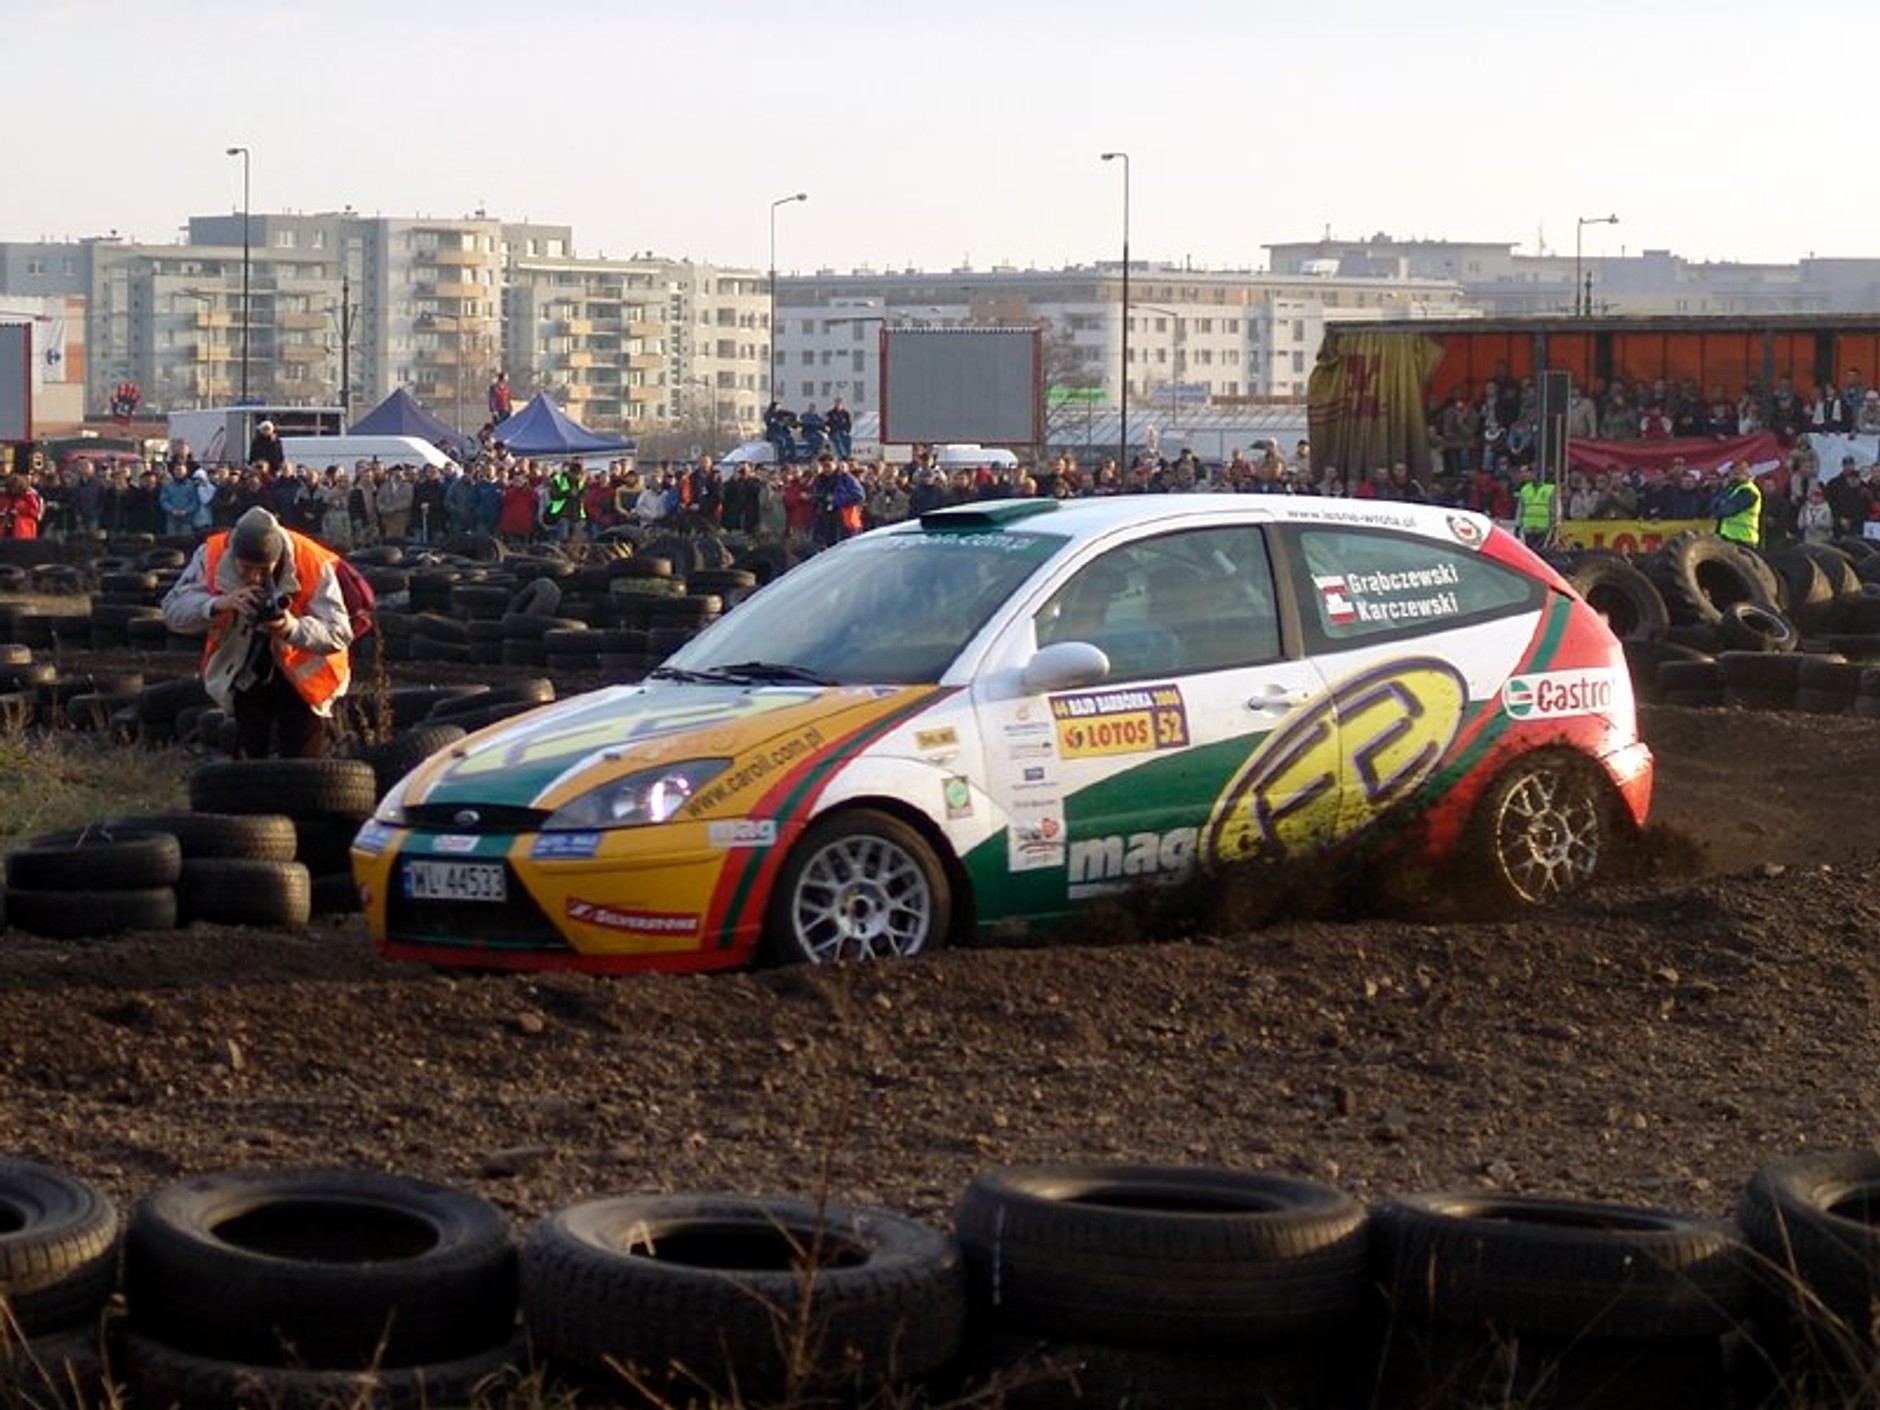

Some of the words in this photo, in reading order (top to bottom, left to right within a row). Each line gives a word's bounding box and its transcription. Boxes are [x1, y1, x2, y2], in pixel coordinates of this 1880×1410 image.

[1346, 563, 1460, 596] Grąbczewski
[1356, 592, 1459, 621] Karczewski
[1537, 677, 1612, 713] Castro
[1088, 719, 1149, 748] LOTOS
[1158, 710, 1184, 744] 52
